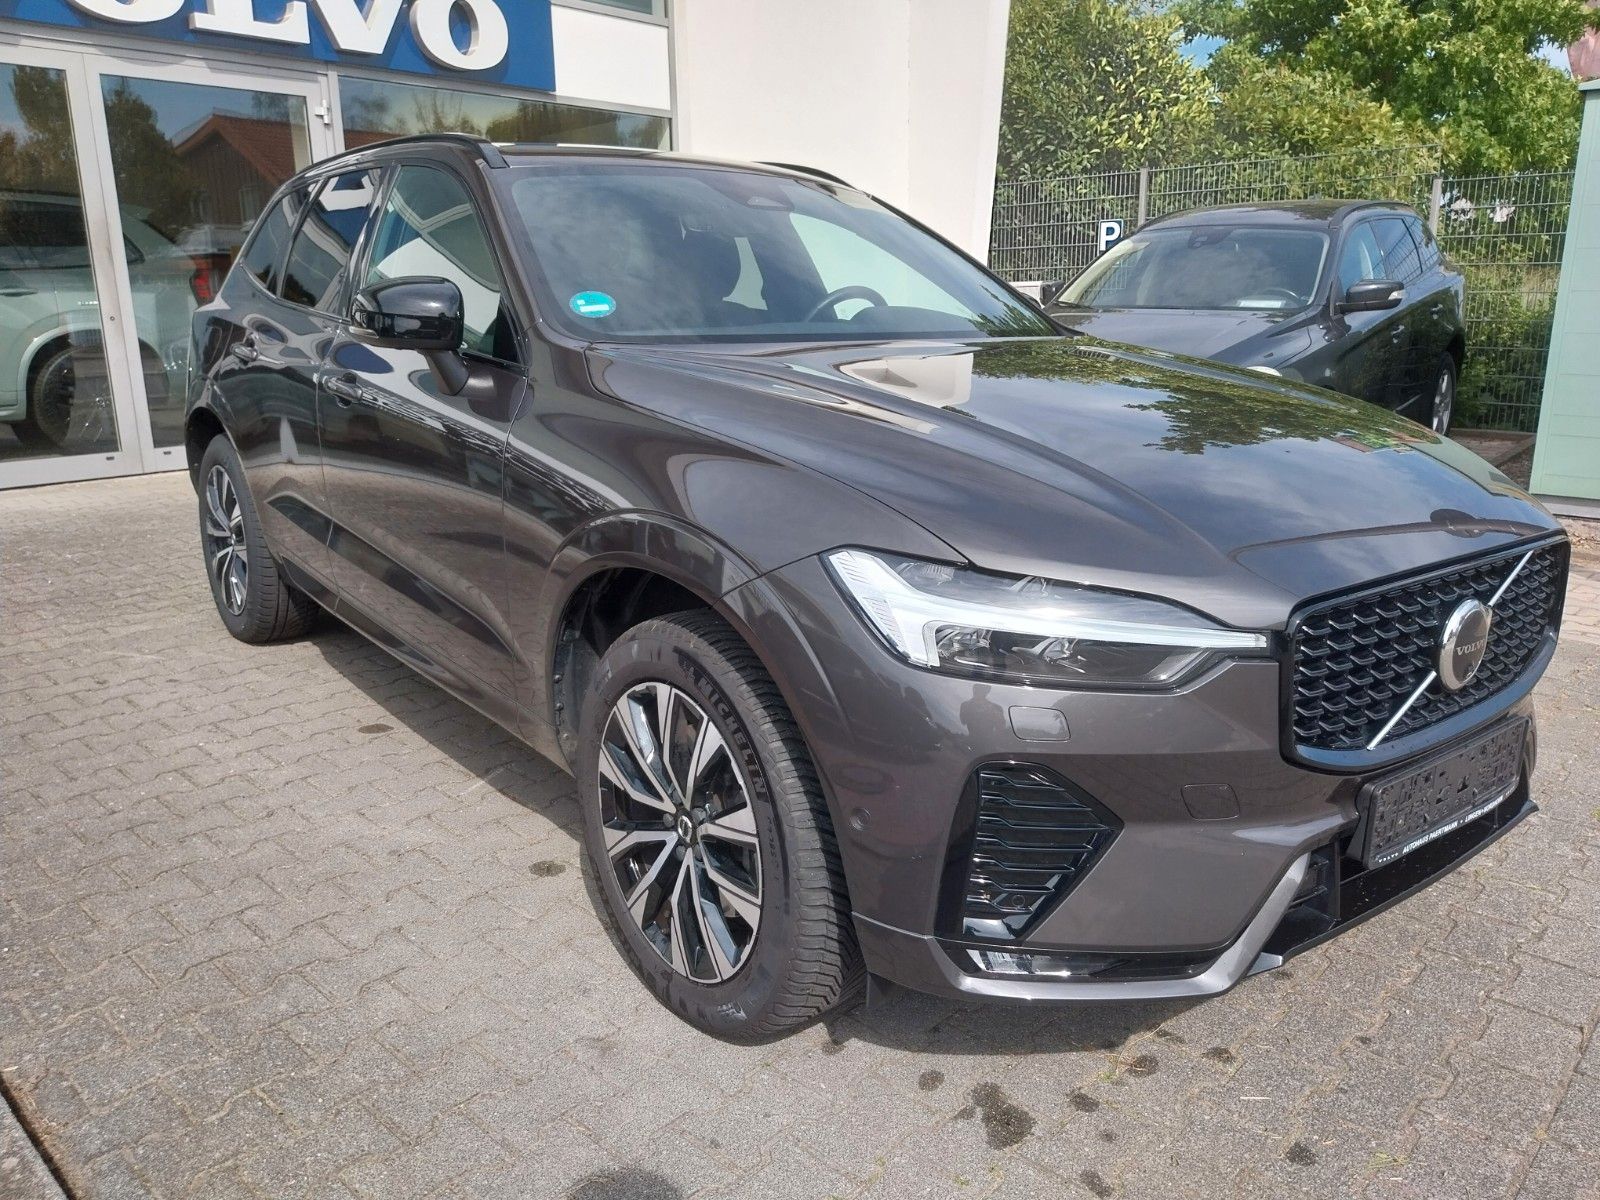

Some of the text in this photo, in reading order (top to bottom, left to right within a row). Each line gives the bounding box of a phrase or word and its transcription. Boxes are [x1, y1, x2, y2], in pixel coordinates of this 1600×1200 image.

[64, 0, 508, 70] LVO
[1100, 222, 1121, 251] P
[697, 676, 767, 792] MICHELIN
[1402, 834, 1429, 854] AUTOHAUS
